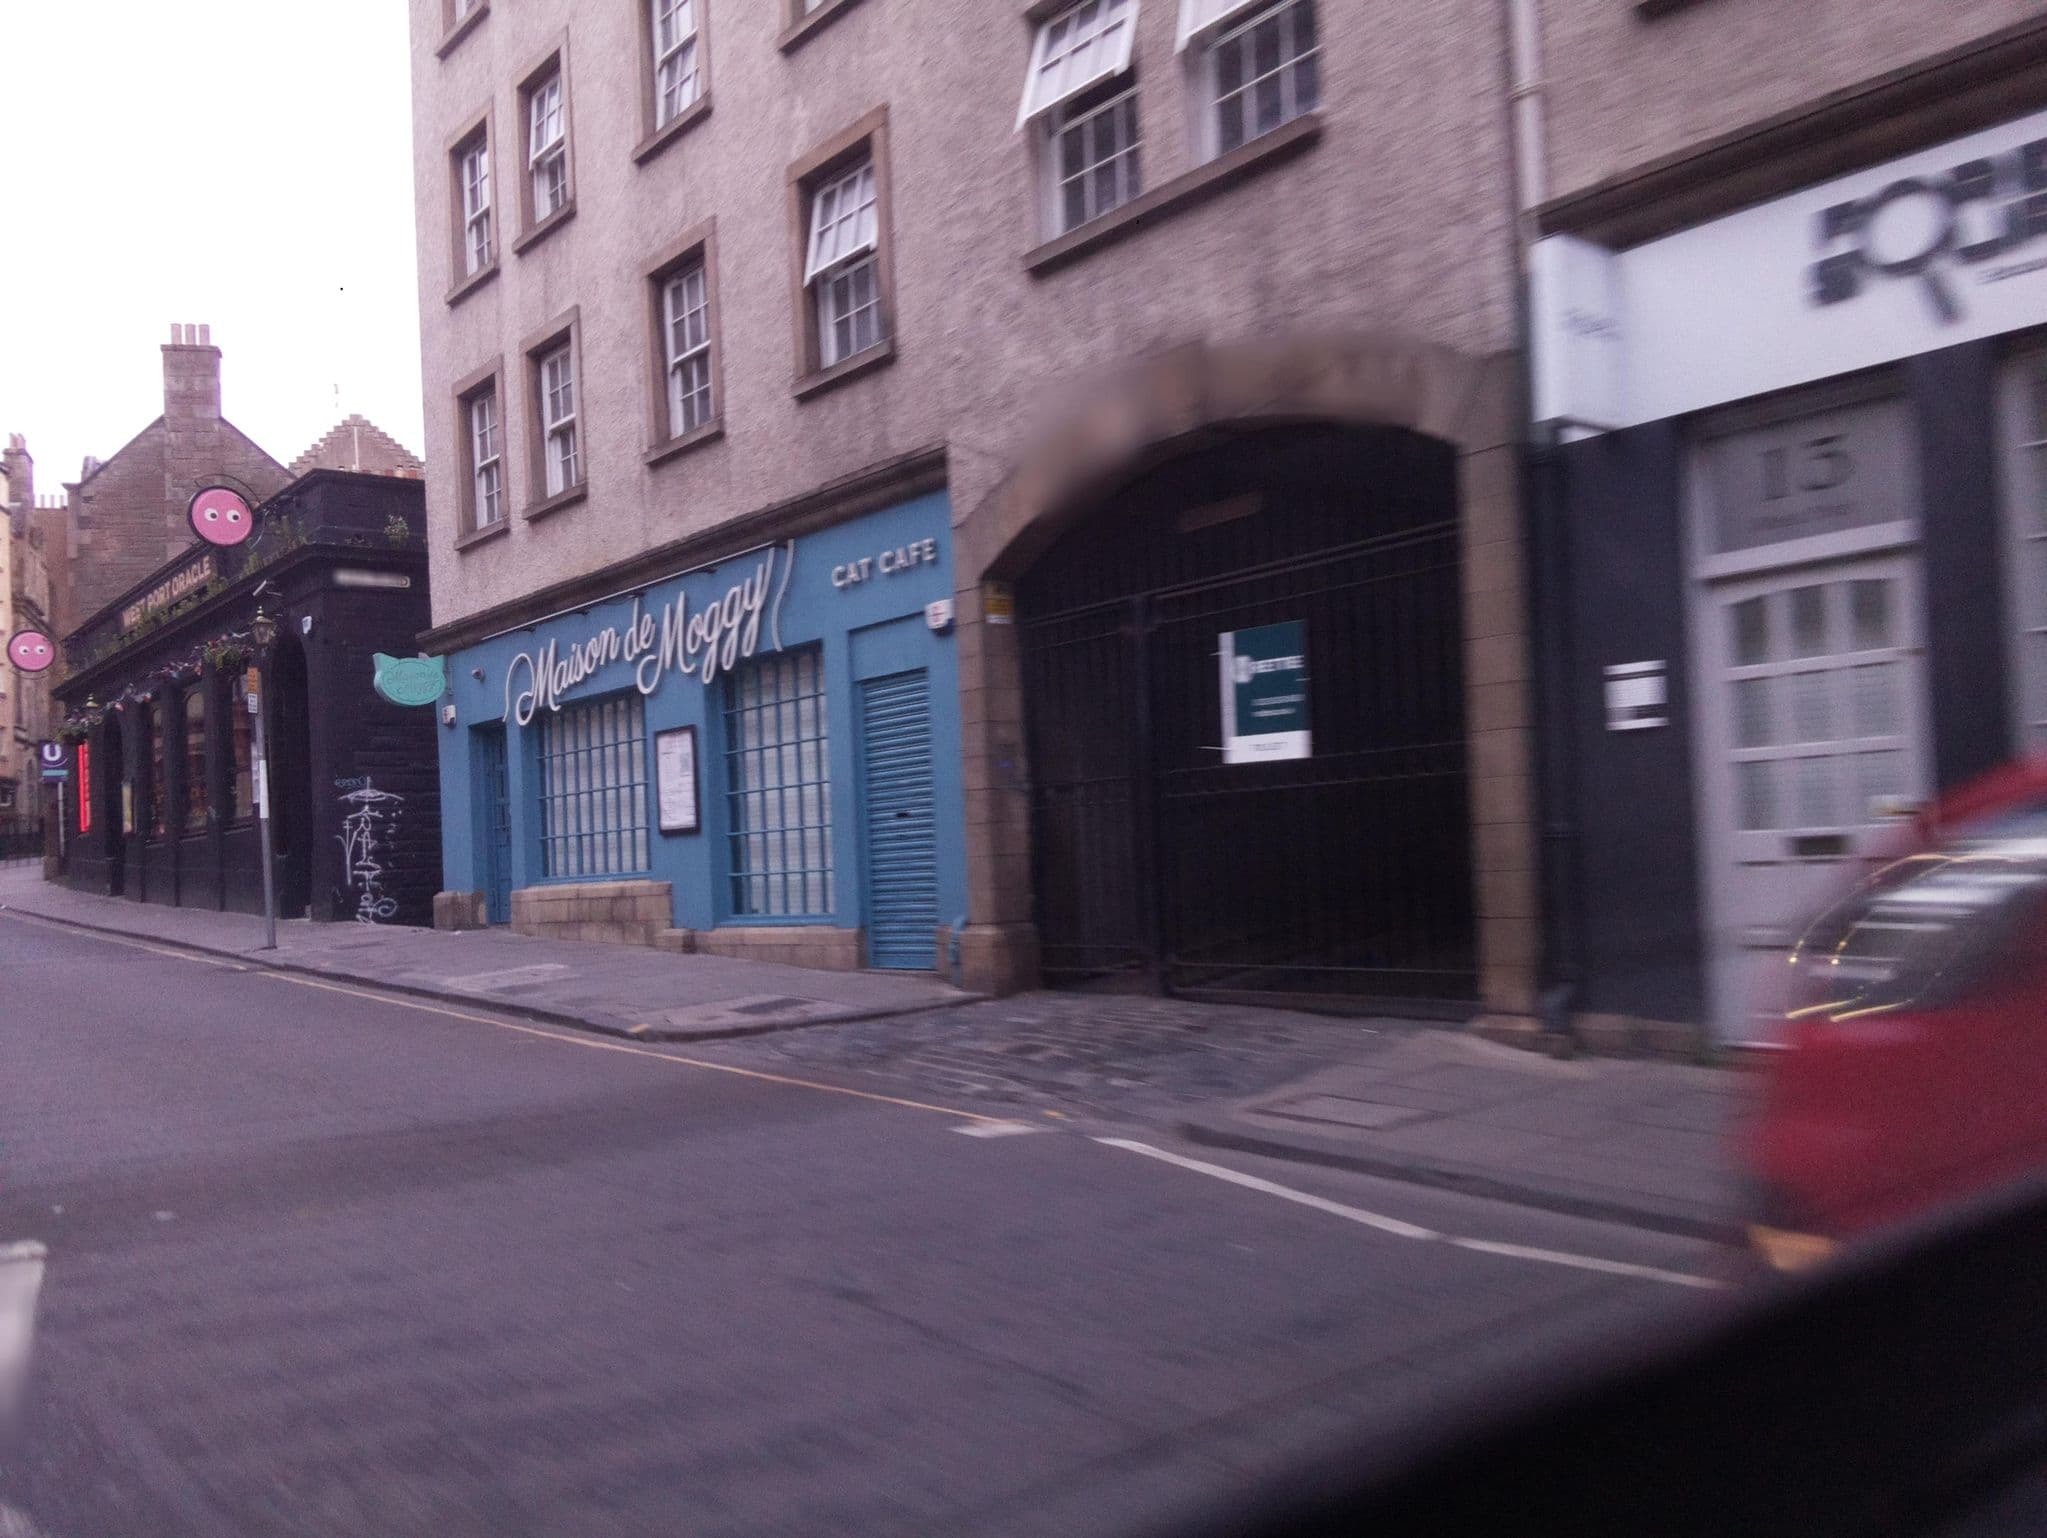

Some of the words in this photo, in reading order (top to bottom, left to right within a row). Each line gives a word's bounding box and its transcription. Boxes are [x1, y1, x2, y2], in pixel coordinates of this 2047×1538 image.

[172, 554, 211, 597] ORACLE
[832, 557, 873, 587] CAT
[879, 538, 936, 573] CAFE
[624, 597, 655, 662] de
[636, 546, 779, 695] Moggy
[502, 627, 620, 726] Maison
